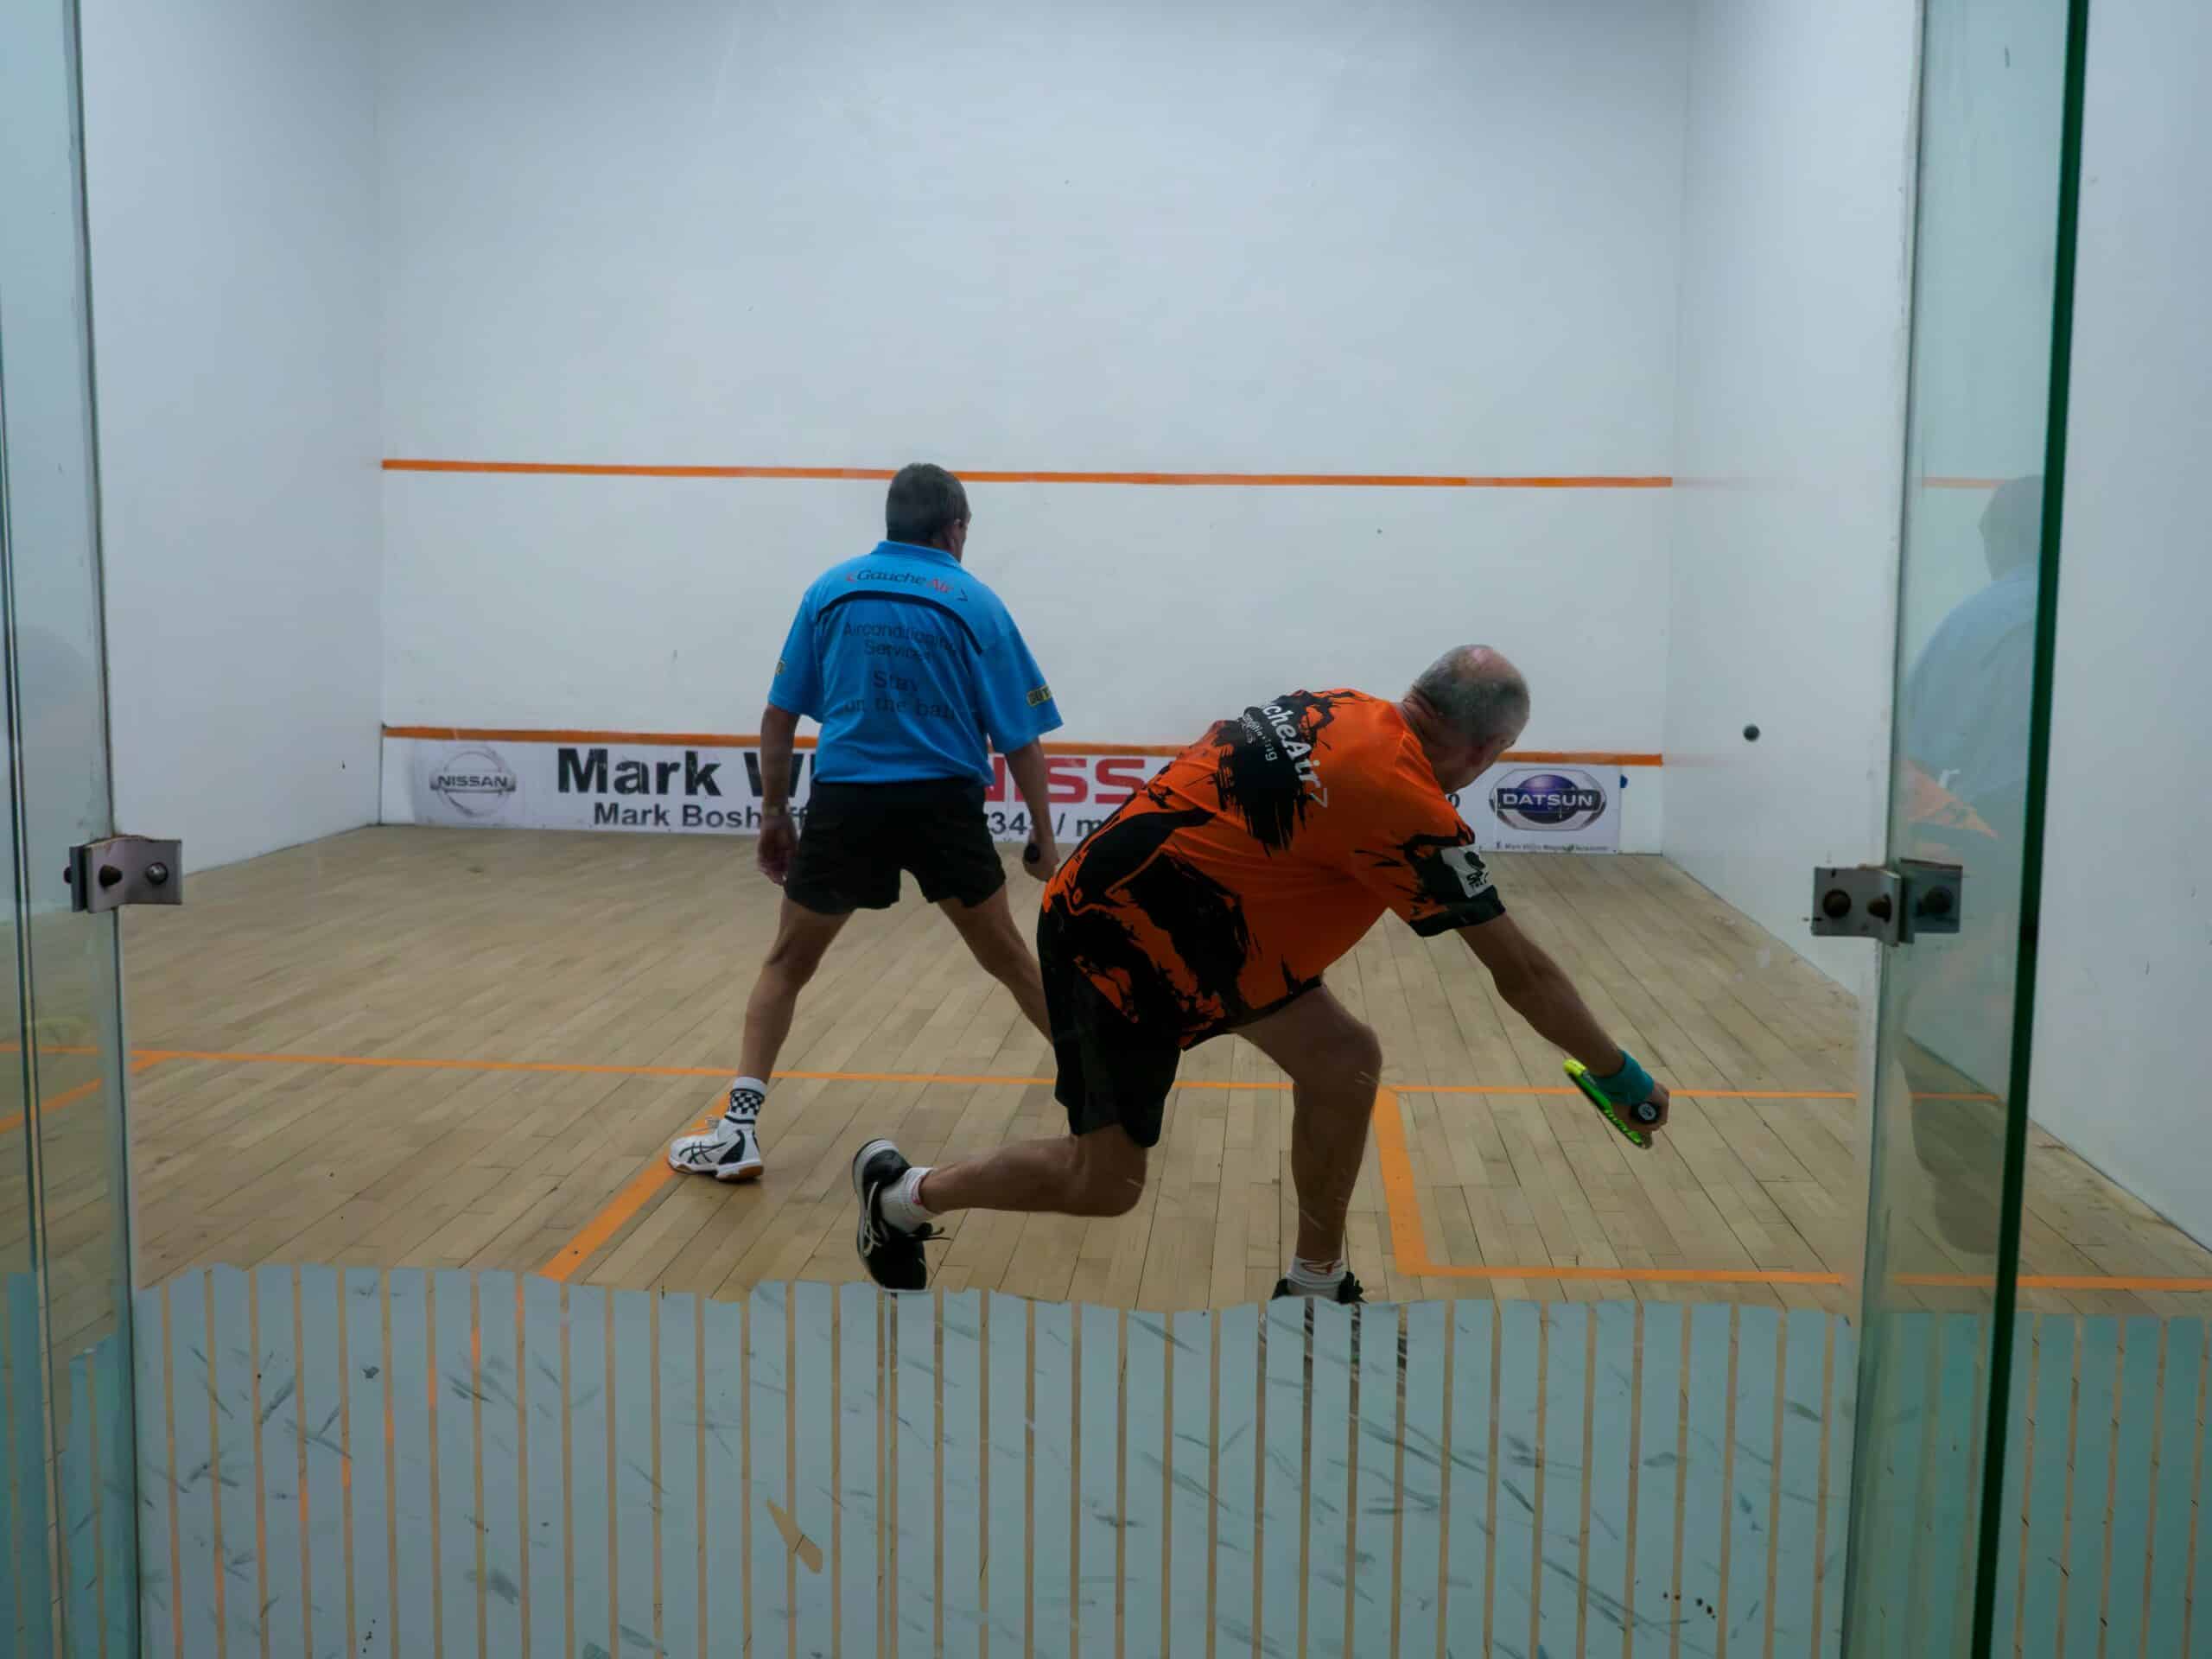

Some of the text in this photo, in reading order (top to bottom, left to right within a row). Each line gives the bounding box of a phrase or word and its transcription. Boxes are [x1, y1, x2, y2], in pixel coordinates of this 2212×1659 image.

[1262, 705, 1321, 788] cheAir
[438, 775, 507, 788] NISSAN
[557, 747, 722, 797] Mark
[1503, 792, 1592, 806] DATSUN
[594, 802, 671, 827] Mark
